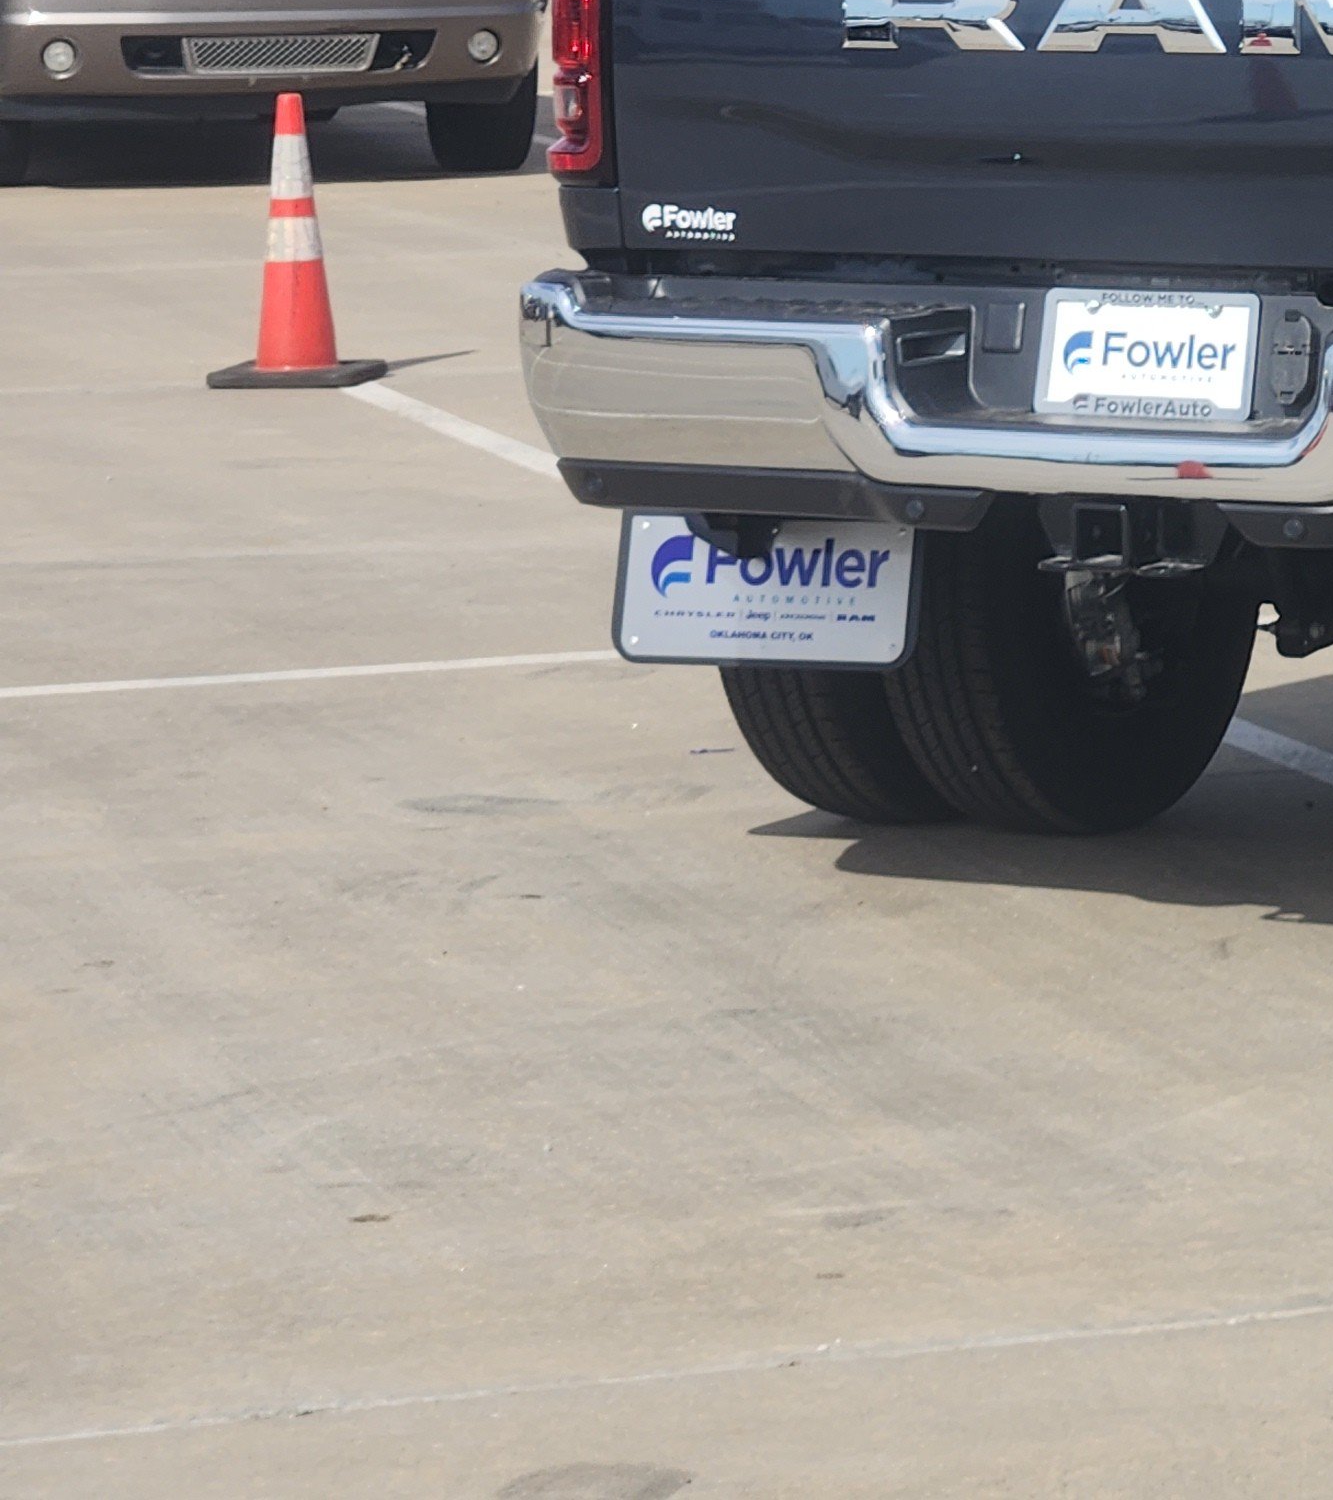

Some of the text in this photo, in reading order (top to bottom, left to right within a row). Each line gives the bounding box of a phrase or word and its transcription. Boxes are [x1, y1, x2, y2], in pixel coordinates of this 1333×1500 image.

[662, 204, 737, 231] Fowler
[1102, 292, 1152, 304] FOLLOW
[1157, 293, 1174, 304] ME
[1102, 331, 1236, 370] Fowler
[1094, 396, 1212, 418] FowlerAuto
[706, 537, 890, 589] Fowler
[732, 594, 856, 607] AUTOMOTIVE
[654, 610, 736, 618] CHRYSLER
[746, 609, 771, 622] Jeep
[709, 629, 767, 640] OKLAHOMA
[799, 632, 814, 641] OK
